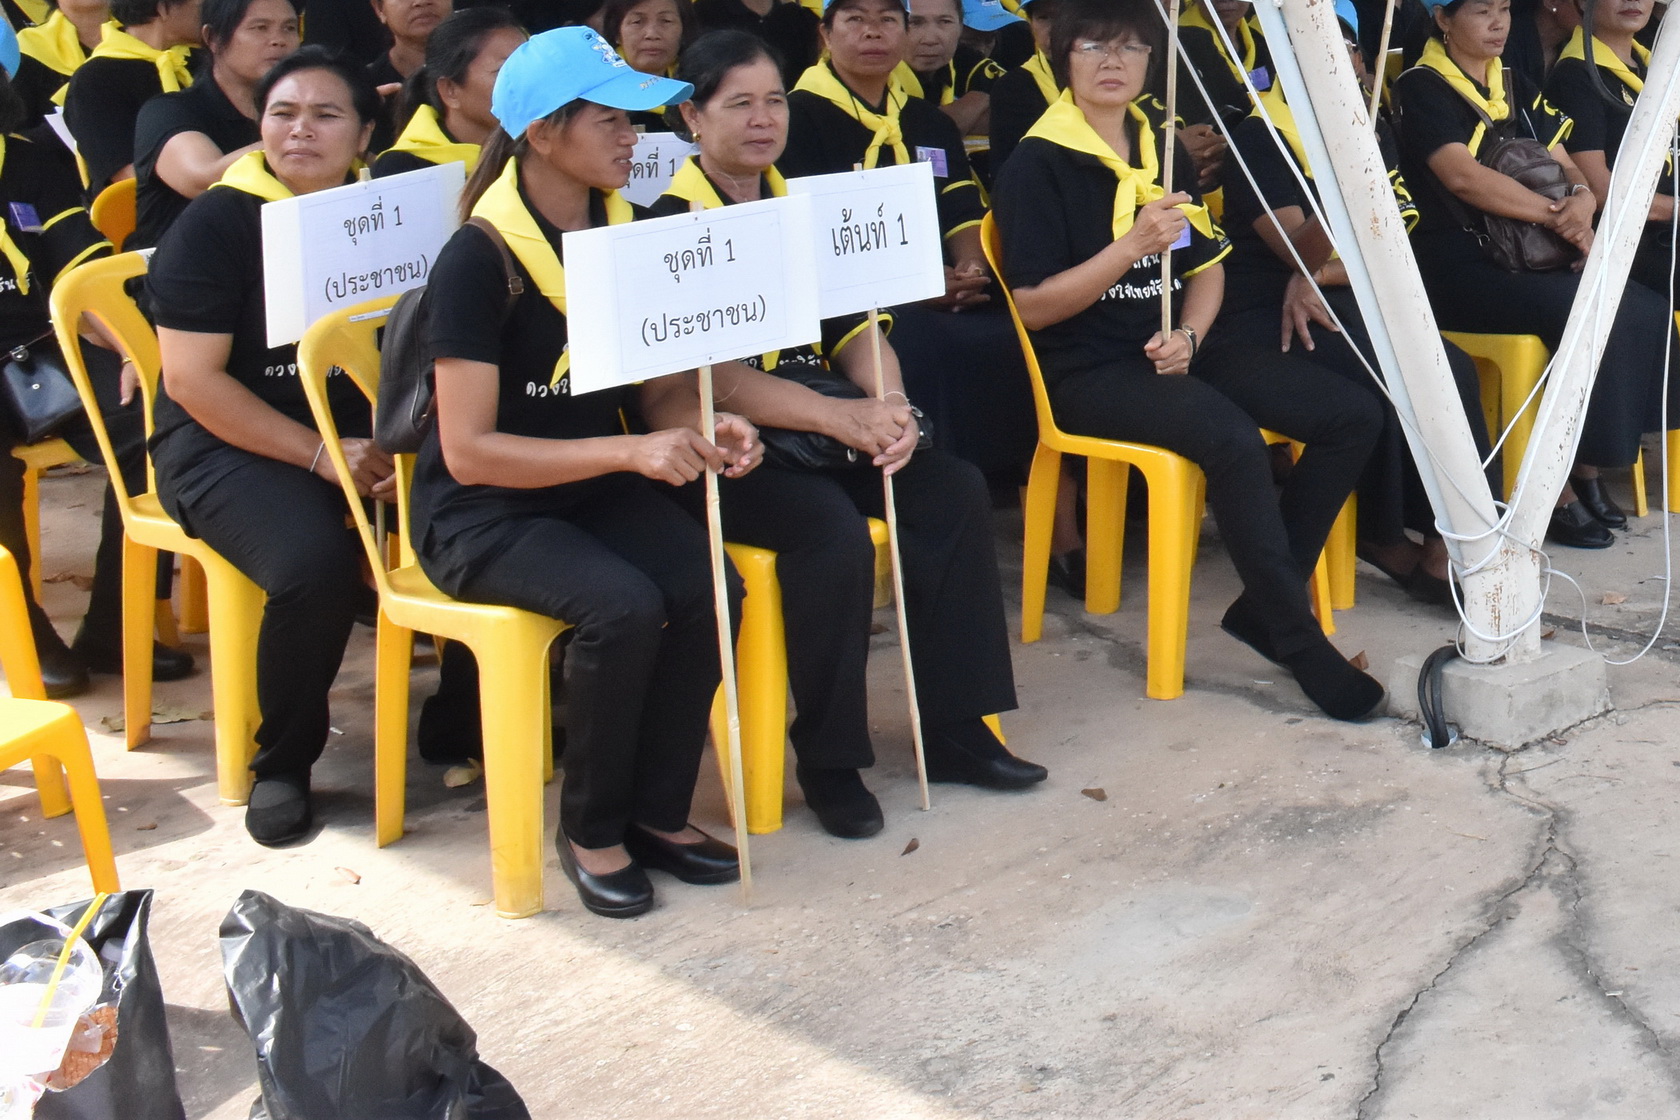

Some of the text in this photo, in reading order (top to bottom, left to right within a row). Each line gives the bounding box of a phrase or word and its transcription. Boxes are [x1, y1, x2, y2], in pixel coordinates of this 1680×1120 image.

[343, 195, 403, 246] ชุดที่ 1
[831, 201, 909, 257] เต้นท์ 1
[325, 254, 428, 303] (ประชาชน)
[663, 227, 736, 284] ชุดที่ 1
[641, 294, 767, 347] (ประชาชน)
